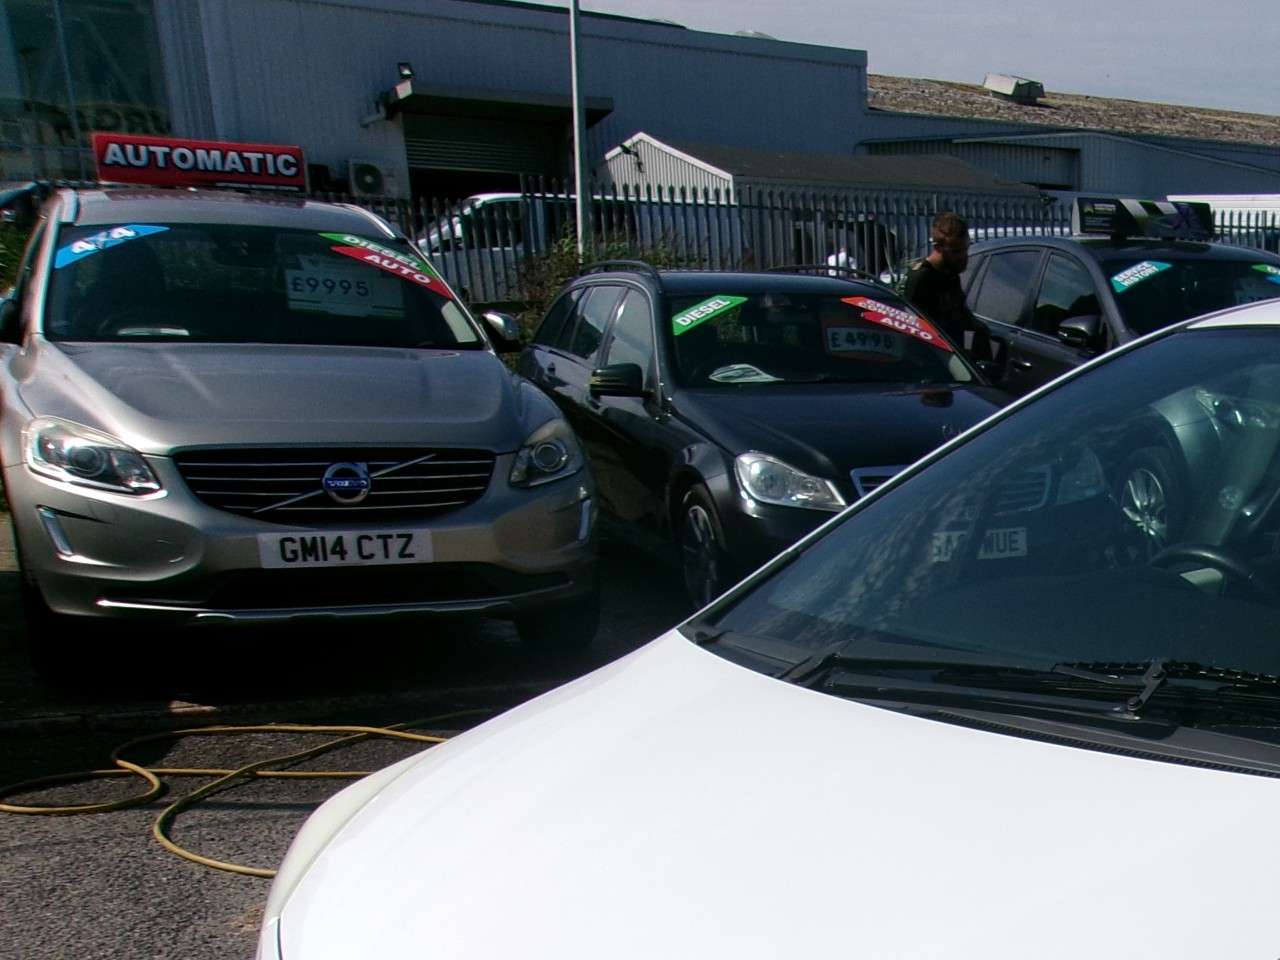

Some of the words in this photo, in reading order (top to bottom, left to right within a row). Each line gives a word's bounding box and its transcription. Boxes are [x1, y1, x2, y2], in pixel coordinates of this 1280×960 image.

[103, 142, 299, 177] AUTOMATIC
[342, 235, 422, 271] DIESEL
[363, 254, 432, 284] AUTO
[291, 276, 370, 297] £9995
[676, 299, 731, 326] DIESEL
[880, 317, 933, 340] AUTO
[279, 535, 348, 563] GM14
[356, 533, 415, 560] CTZ
